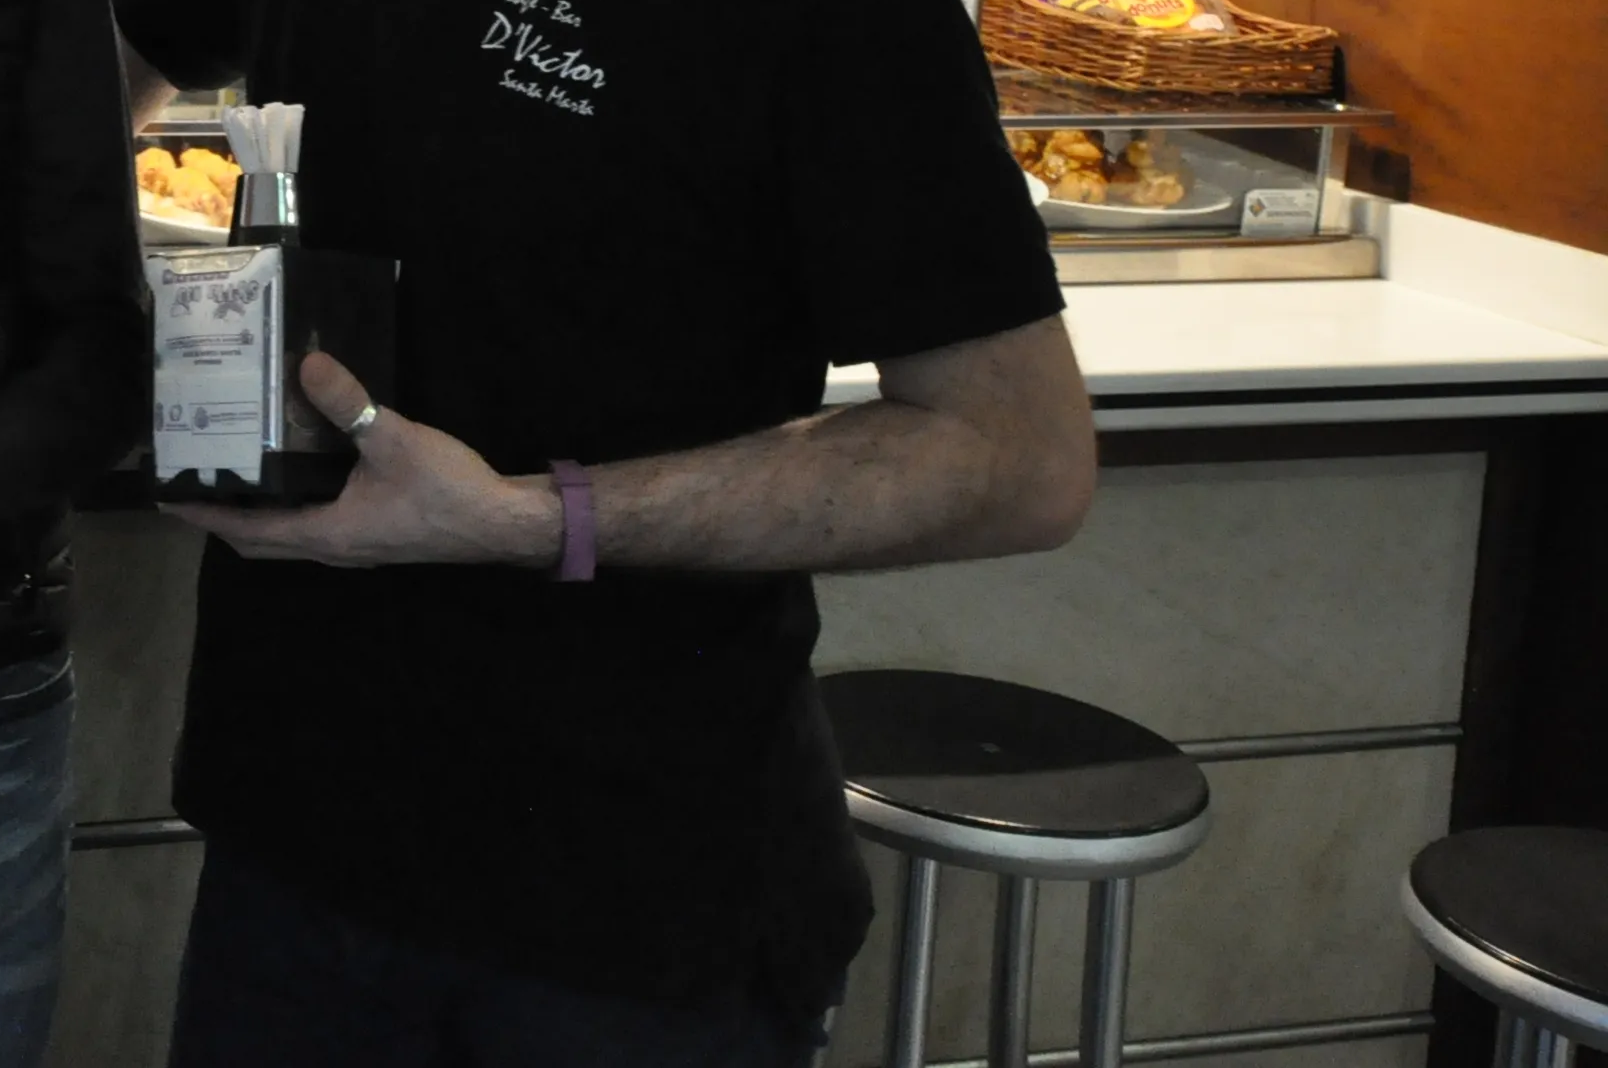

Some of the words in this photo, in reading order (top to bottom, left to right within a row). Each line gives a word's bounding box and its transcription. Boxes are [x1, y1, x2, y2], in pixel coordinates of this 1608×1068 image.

[550, 0, 582, 28] Bar
[499, 69, 542, 99] Santa
[545, 86, 594, 116] Marta
